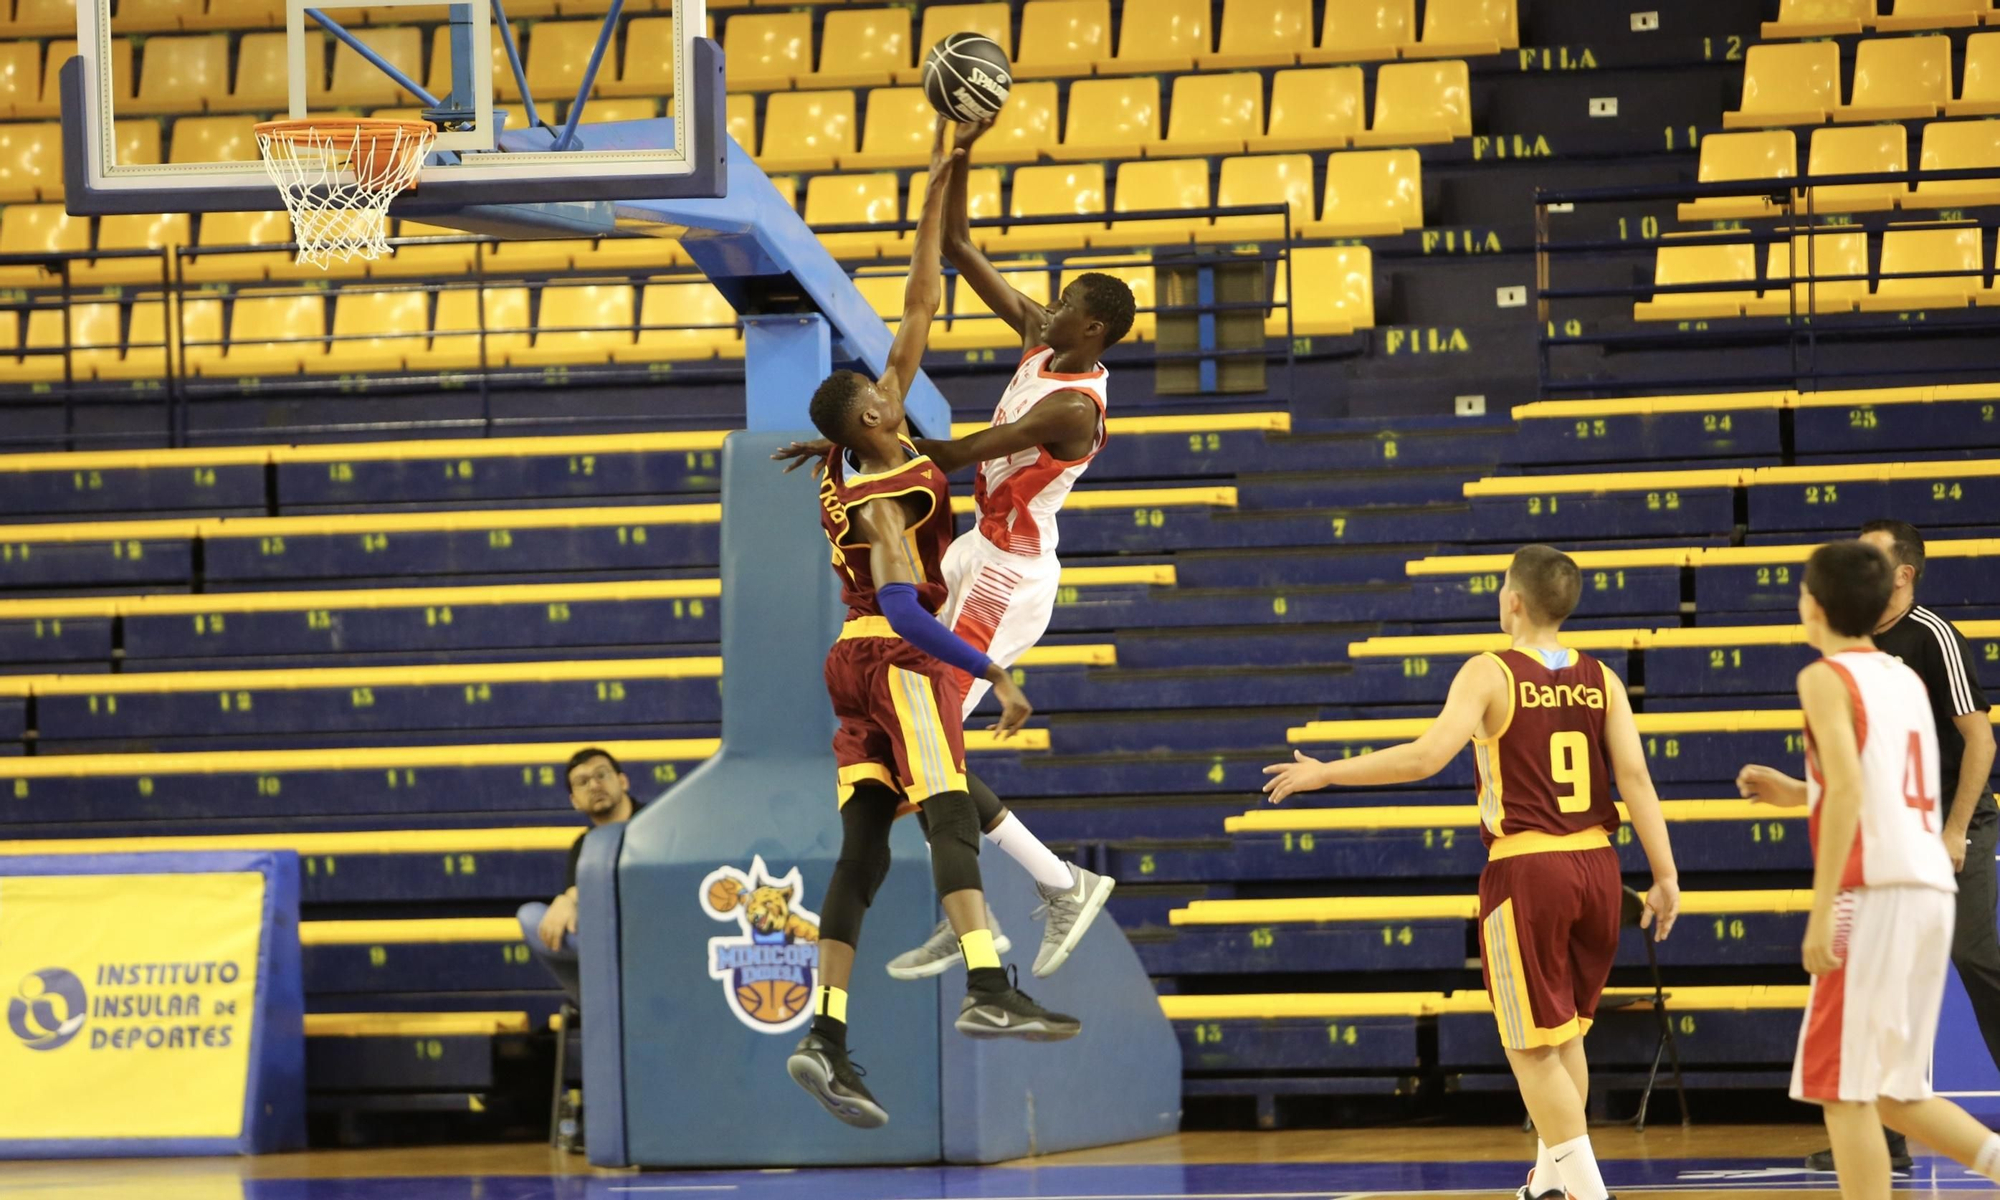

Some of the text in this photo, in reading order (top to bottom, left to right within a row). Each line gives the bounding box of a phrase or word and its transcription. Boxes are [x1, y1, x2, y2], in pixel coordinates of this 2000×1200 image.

[1519, 36, 1742, 71] FILA 12
[1473, 126, 1697, 160] FILA 11
[1422, 216, 1658, 253] FILA 10
[1386, 328, 1469, 354] FILA
[820, 478, 846, 524] nkia
[1549, 731, 1591, 813] 9
[1903, 730, 1935, 833] 4
[96, 961, 239, 987] INSTITUTO
[93, 994, 235, 1018] INSULAR DE
[90, 1025, 233, 1049] DEPORTES
